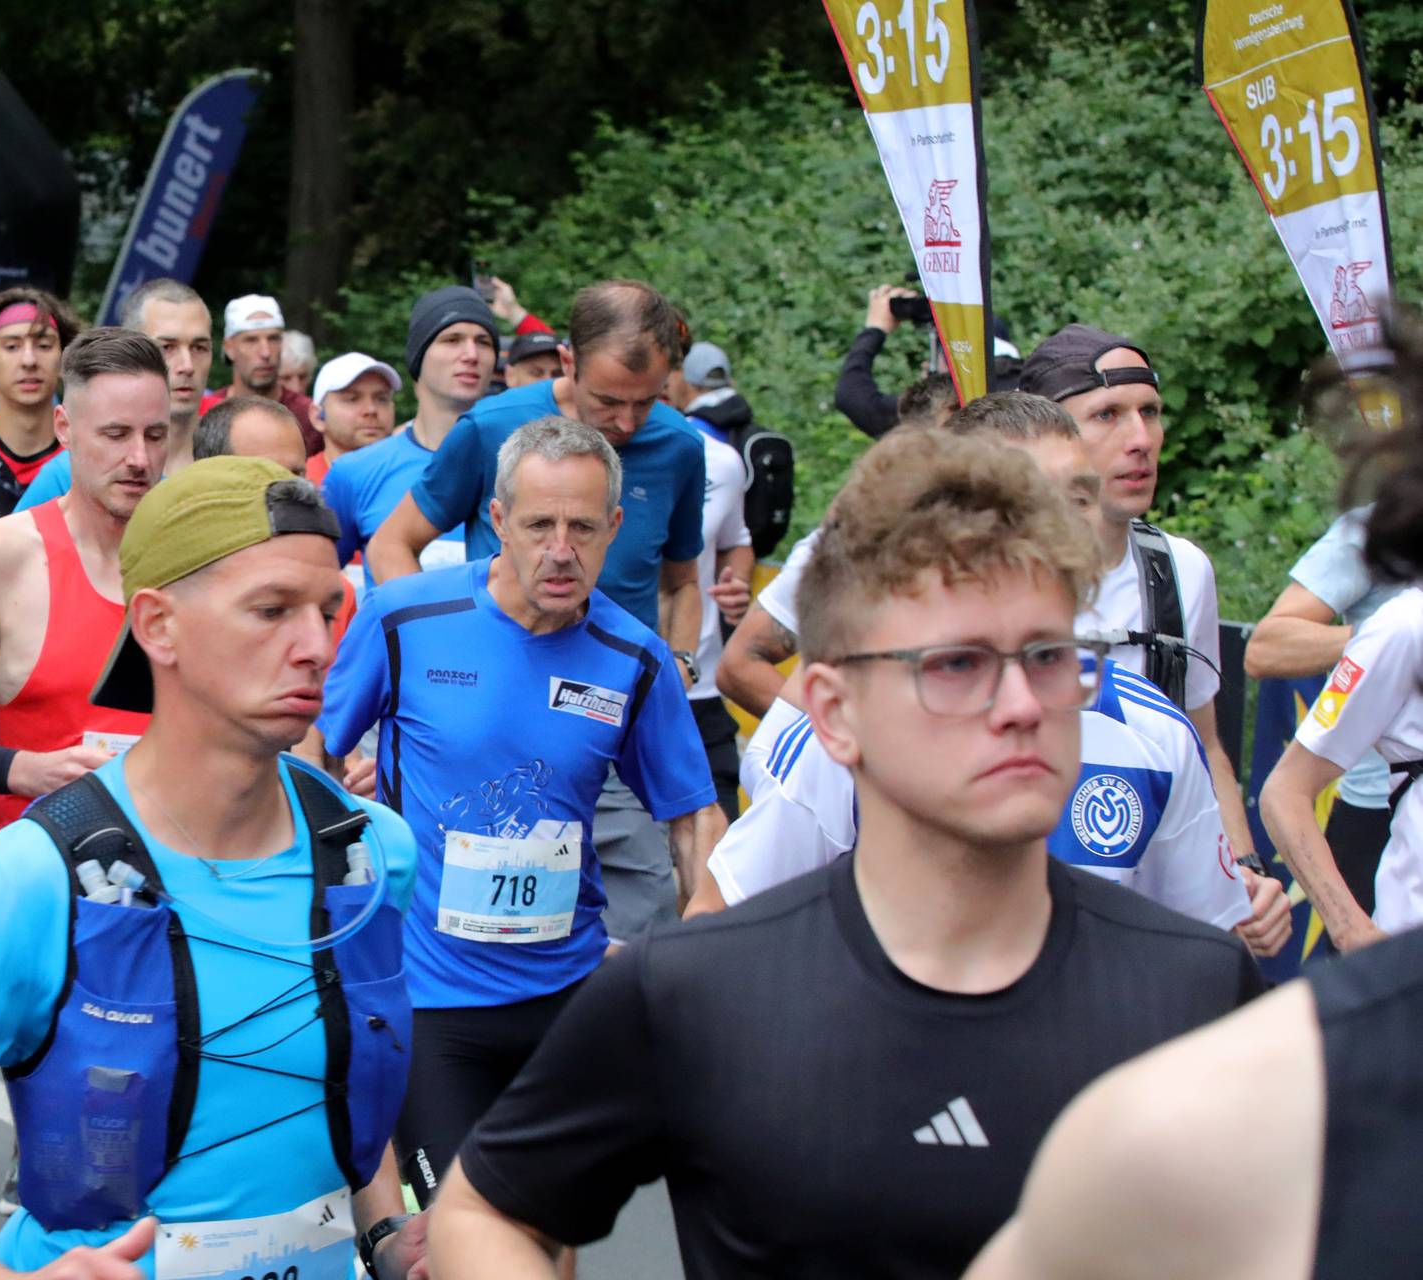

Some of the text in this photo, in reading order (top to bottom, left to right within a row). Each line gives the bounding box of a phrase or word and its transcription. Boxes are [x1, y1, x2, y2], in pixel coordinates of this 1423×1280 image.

[856, 0, 950, 94] 3:15
[1246, 75, 1276, 109] SUB
[1260, 87, 1361, 200] 3:15
[135, 113, 222, 270] bunert
[427, 669, 478, 681] panzeri
[558, 688, 621, 717] Harzheim
[1074, 779, 1099, 845] MEIDERICHER
[1102, 777, 1115, 786] SV
[1125, 790, 1141, 844] DUISBURG
[491, 874, 537, 907] 718
[81, 1002, 154, 1024] SALOMON
[417, 1148, 437, 1188] FUSION
